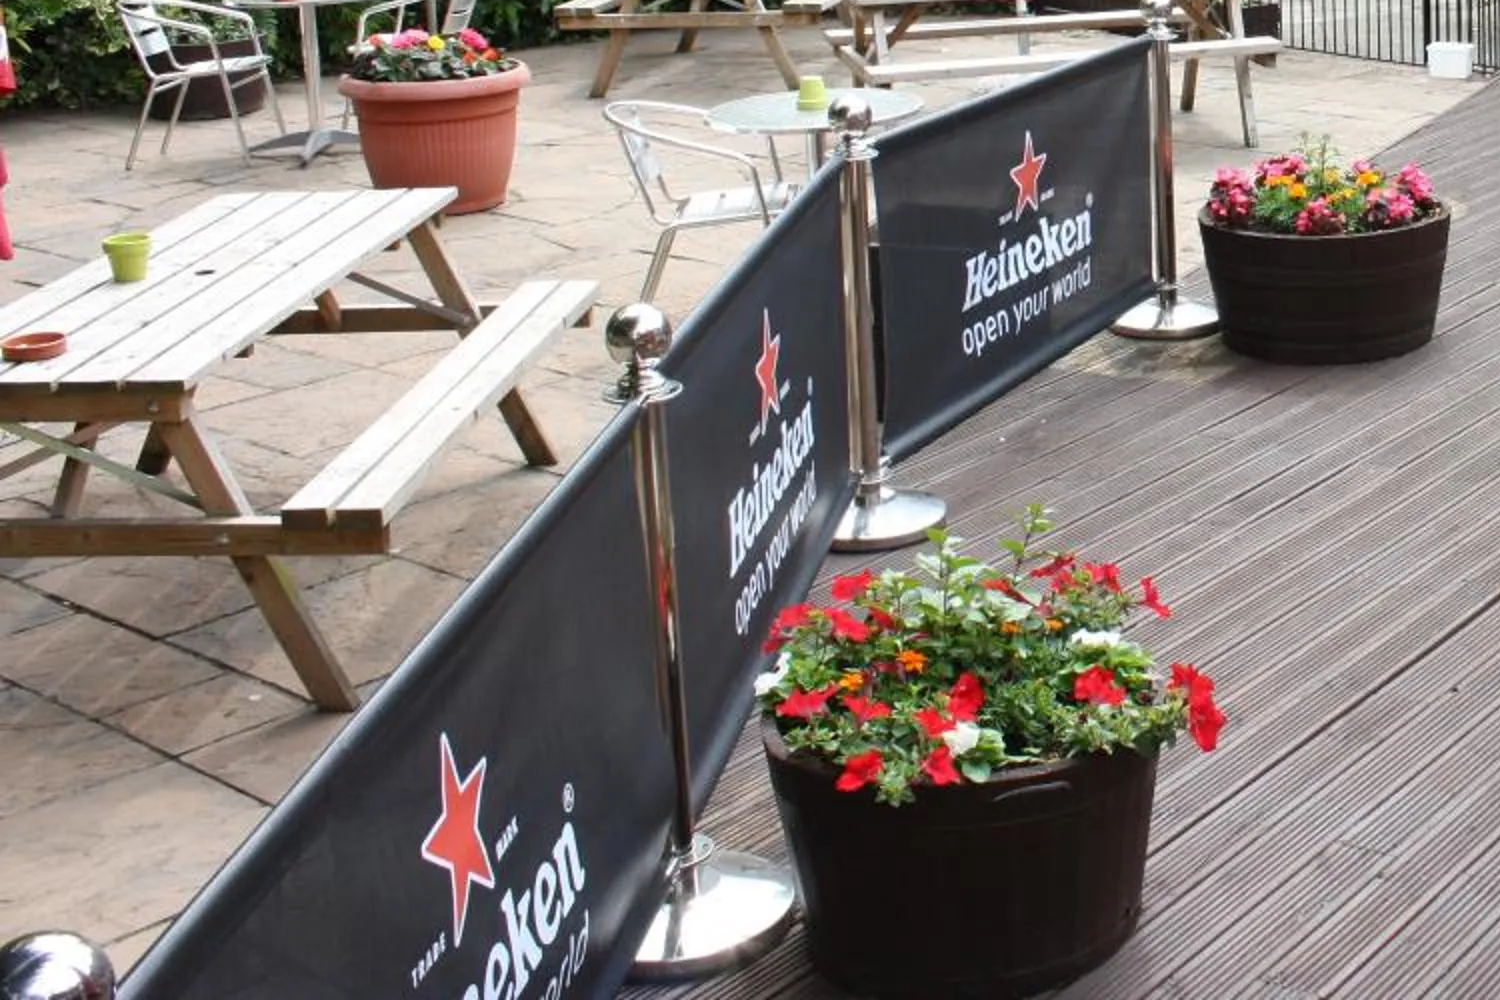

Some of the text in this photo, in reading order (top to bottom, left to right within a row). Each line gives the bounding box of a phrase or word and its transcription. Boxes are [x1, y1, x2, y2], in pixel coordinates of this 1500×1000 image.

[961, 209, 1093, 313] Heineken
[962, 256, 1091, 358] open your world
[728, 399, 815, 578] Heineken
[735, 459, 817, 635] open your world
[463, 821, 586, 1000] eken
[538, 908, 589, 1000] orld
